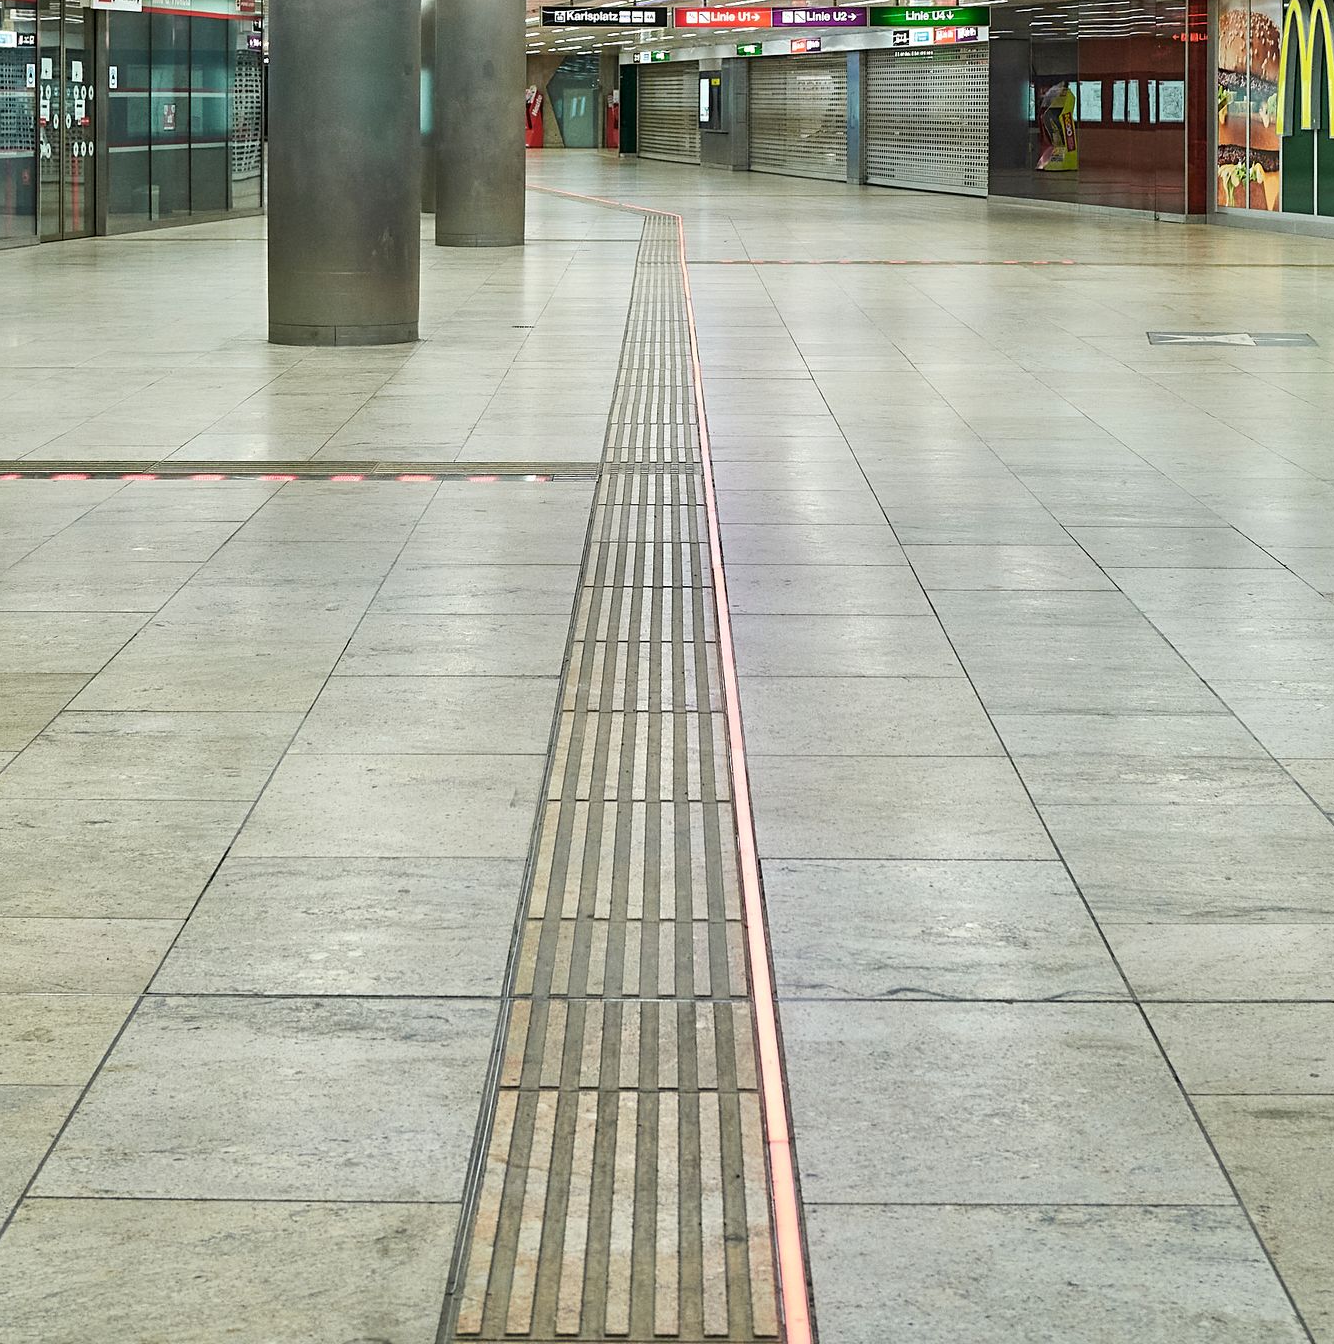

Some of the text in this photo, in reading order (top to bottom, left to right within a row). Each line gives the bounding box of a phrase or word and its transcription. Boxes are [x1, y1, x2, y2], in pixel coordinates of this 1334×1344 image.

[567, 11, 618, 24] Karlsplatz
[710, 11, 751, 22] Linie U1
[806, 11, 848, 22] Linie U2
[905, 10, 946, 21] Linie U4
